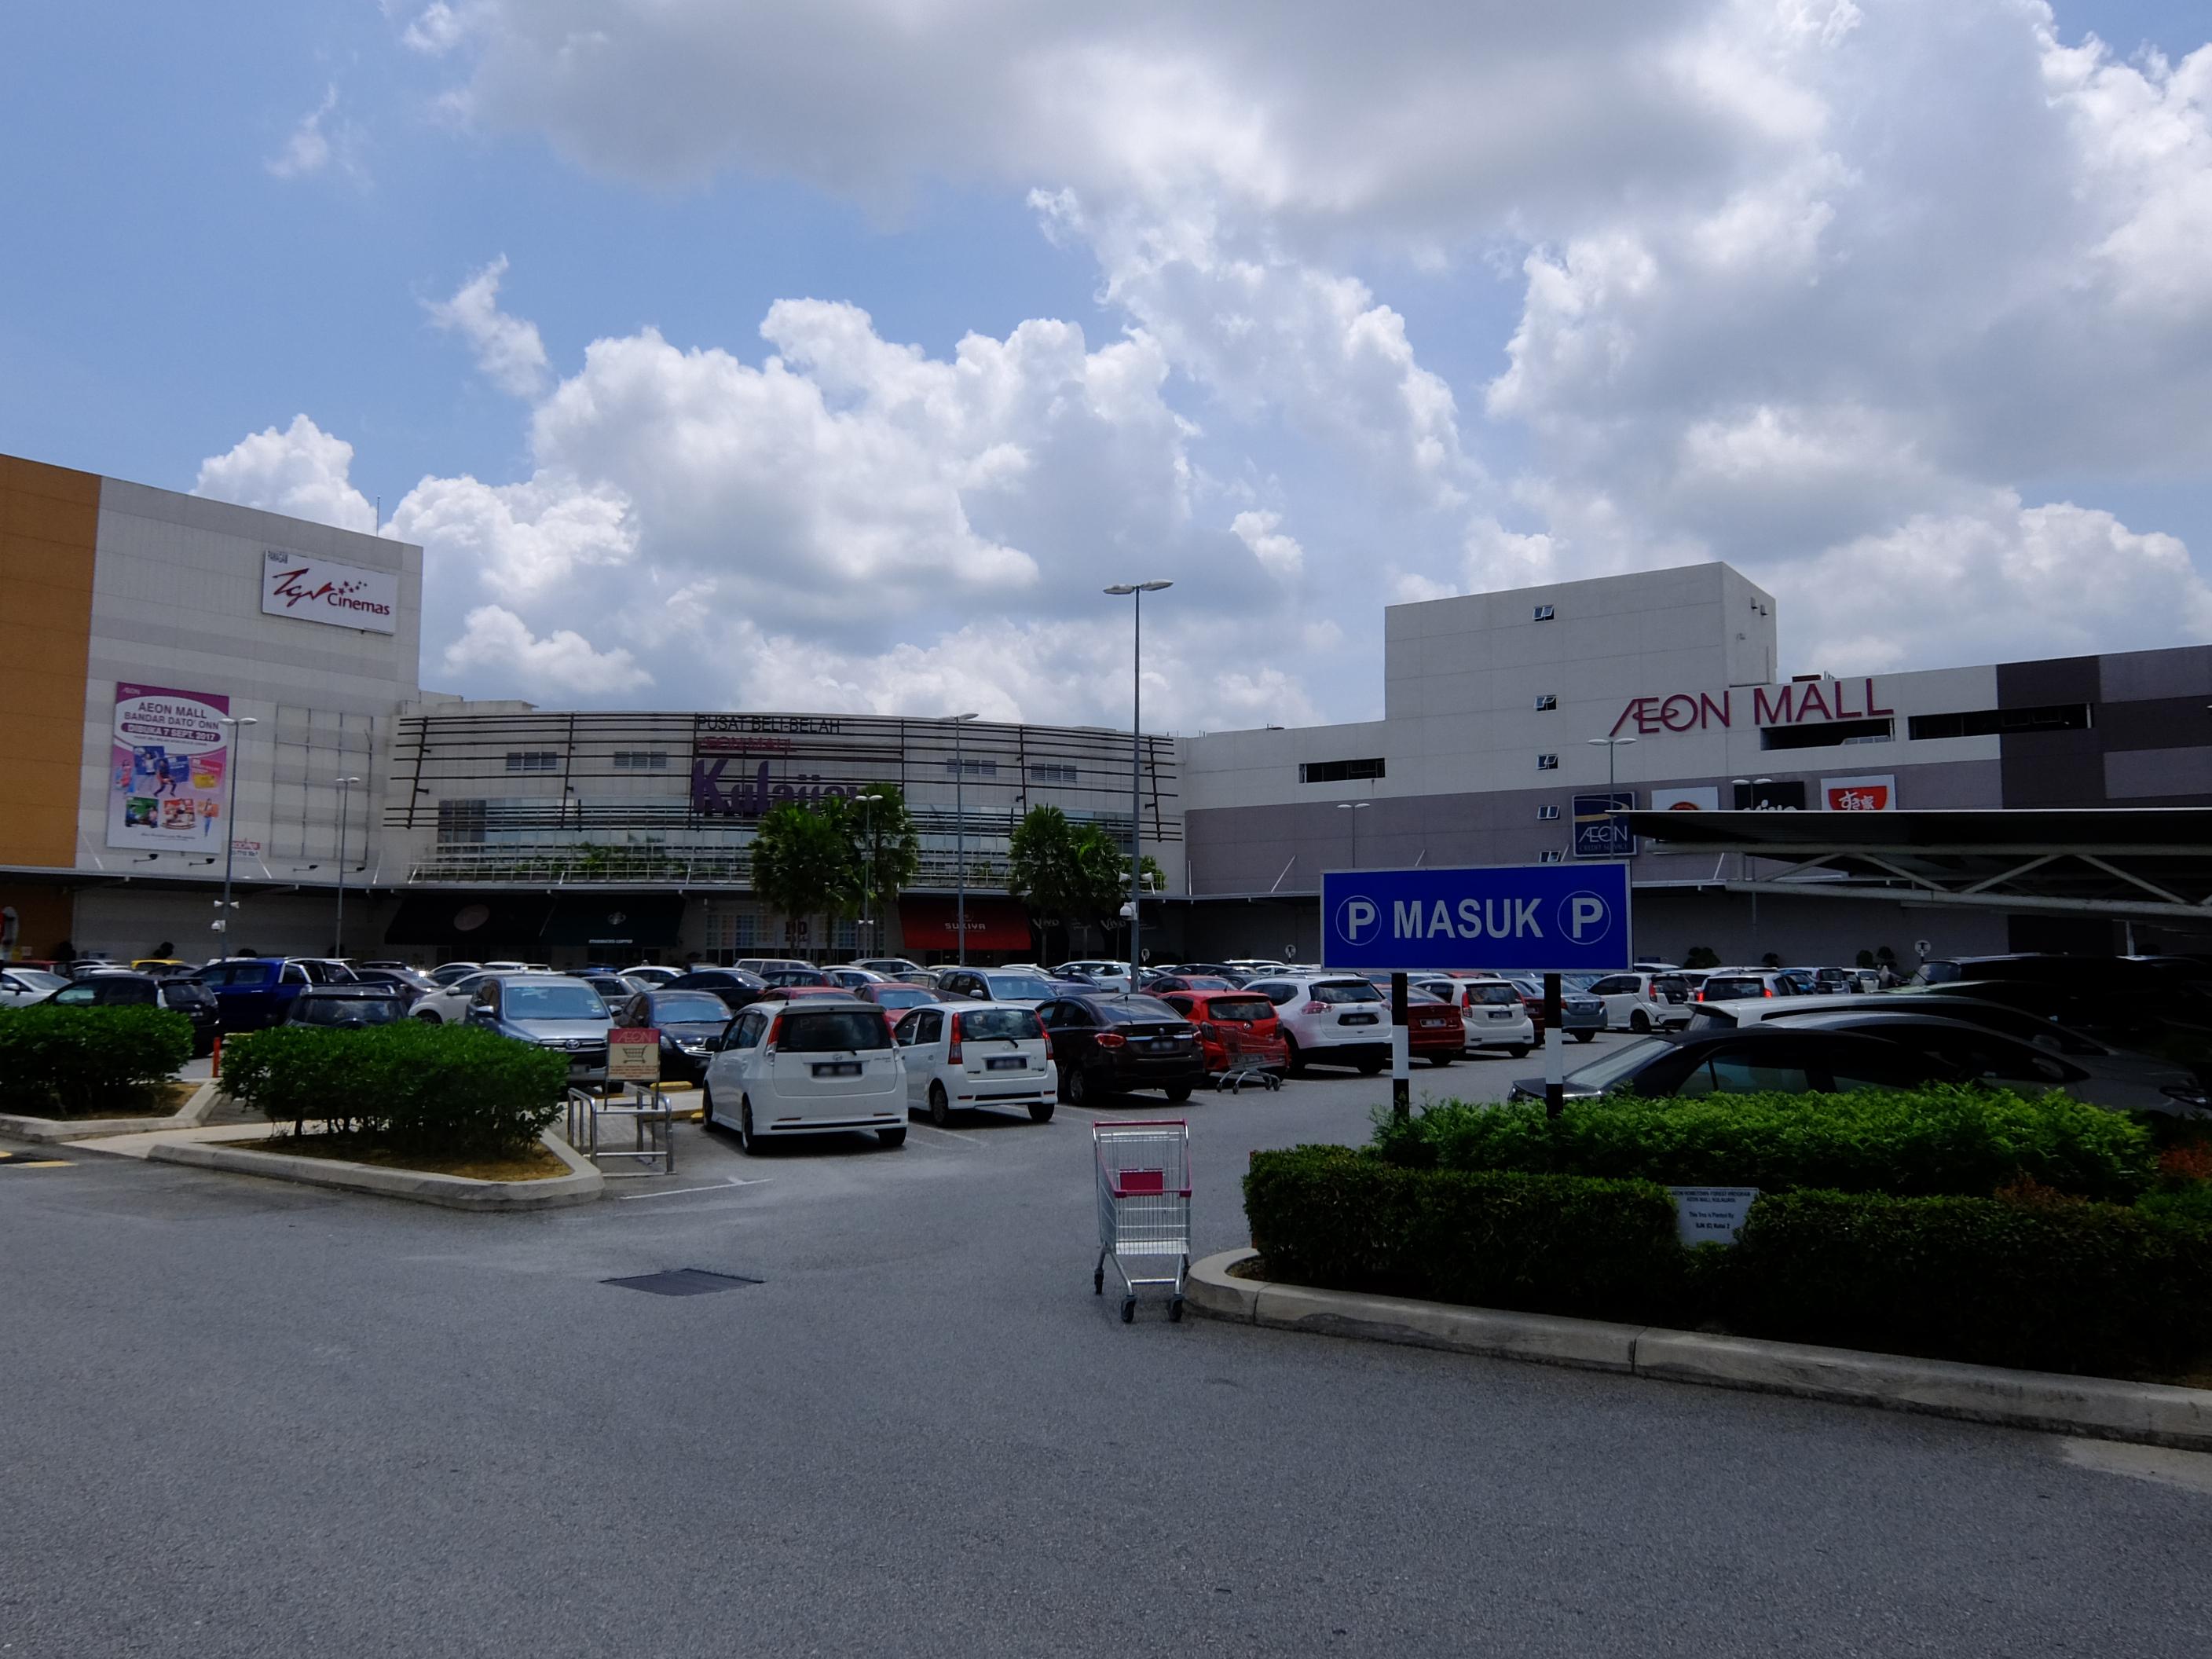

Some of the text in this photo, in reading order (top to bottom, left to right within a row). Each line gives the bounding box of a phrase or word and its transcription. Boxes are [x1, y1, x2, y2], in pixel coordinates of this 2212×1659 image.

[328, 592, 390, 615] Cinemas
[137, 701, 207, 719] AEON MALL
[1753, 678, 1894, 725] MALL
[124, 712, 165, 723] BANDAR
[198, 720, 219, 730] ONN
[697, 716, 840, 734] PUSAT BELI-BELAH
[1348, 897, 1603, 940] P MASUK P
